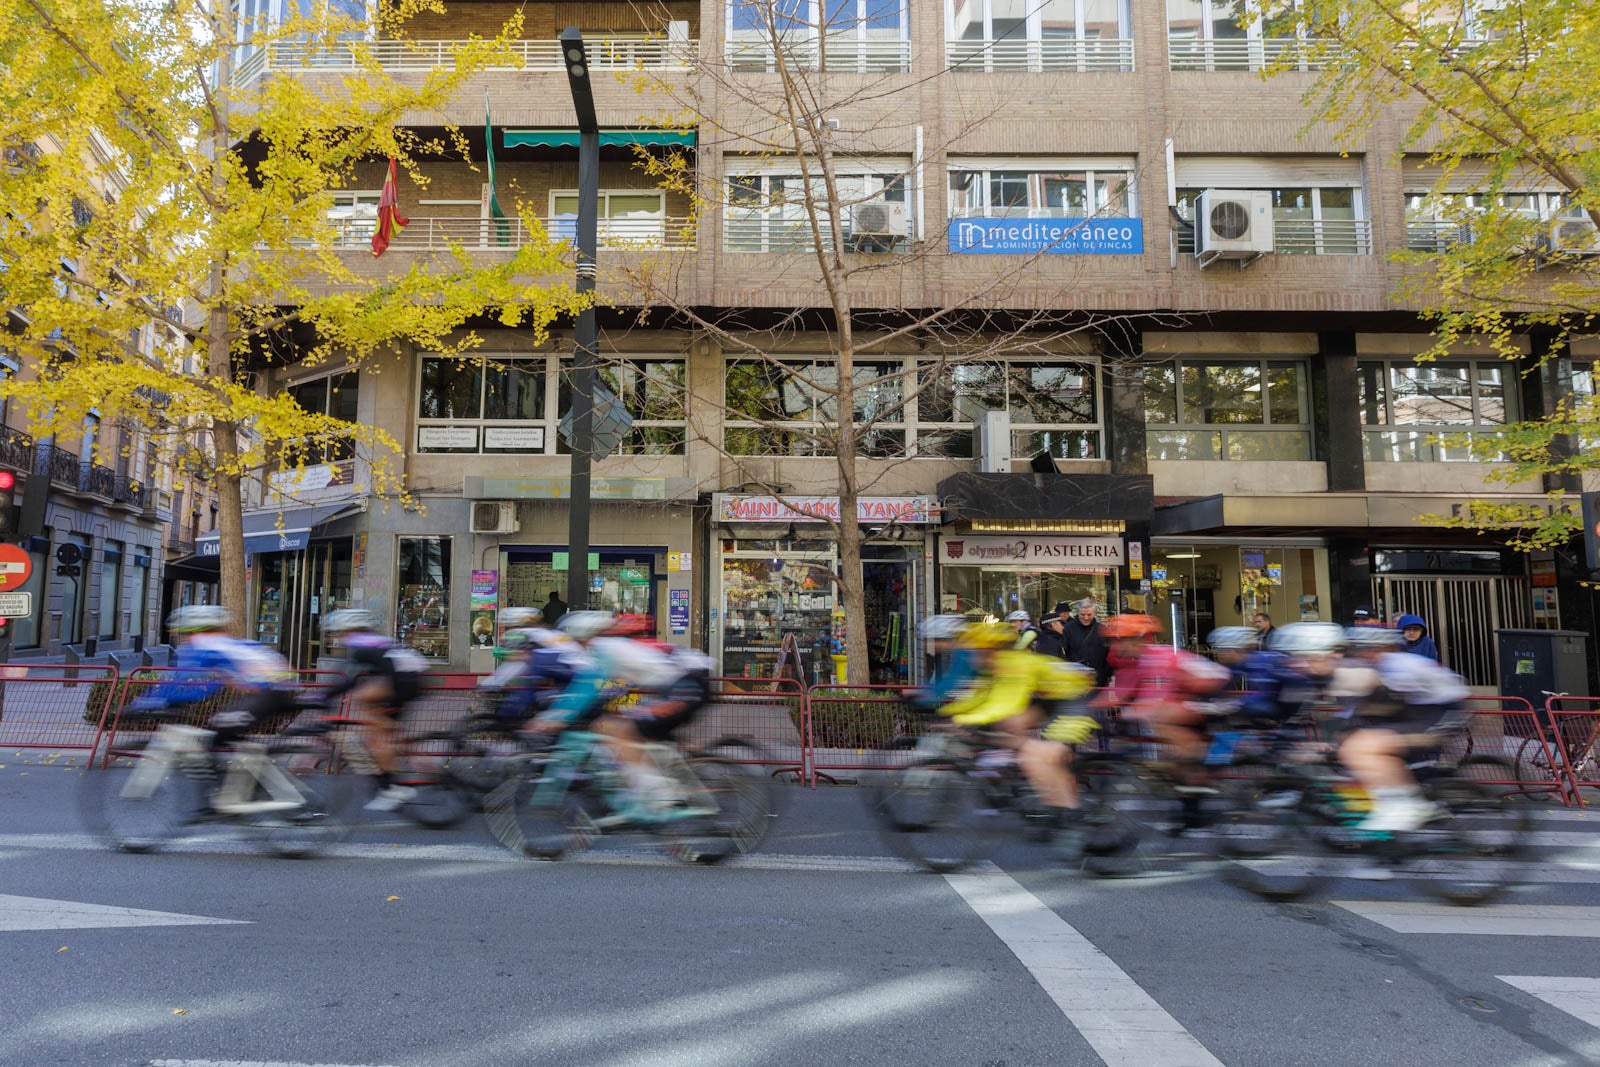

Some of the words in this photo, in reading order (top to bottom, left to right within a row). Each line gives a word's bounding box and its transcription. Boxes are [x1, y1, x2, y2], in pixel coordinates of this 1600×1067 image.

[734, 502, 778, 516] MINI
[784, 502, 842, 516] MARK
[863, 502, 916, 516] YANG
[1034, 545, 1119, 557] PASTELERIA
